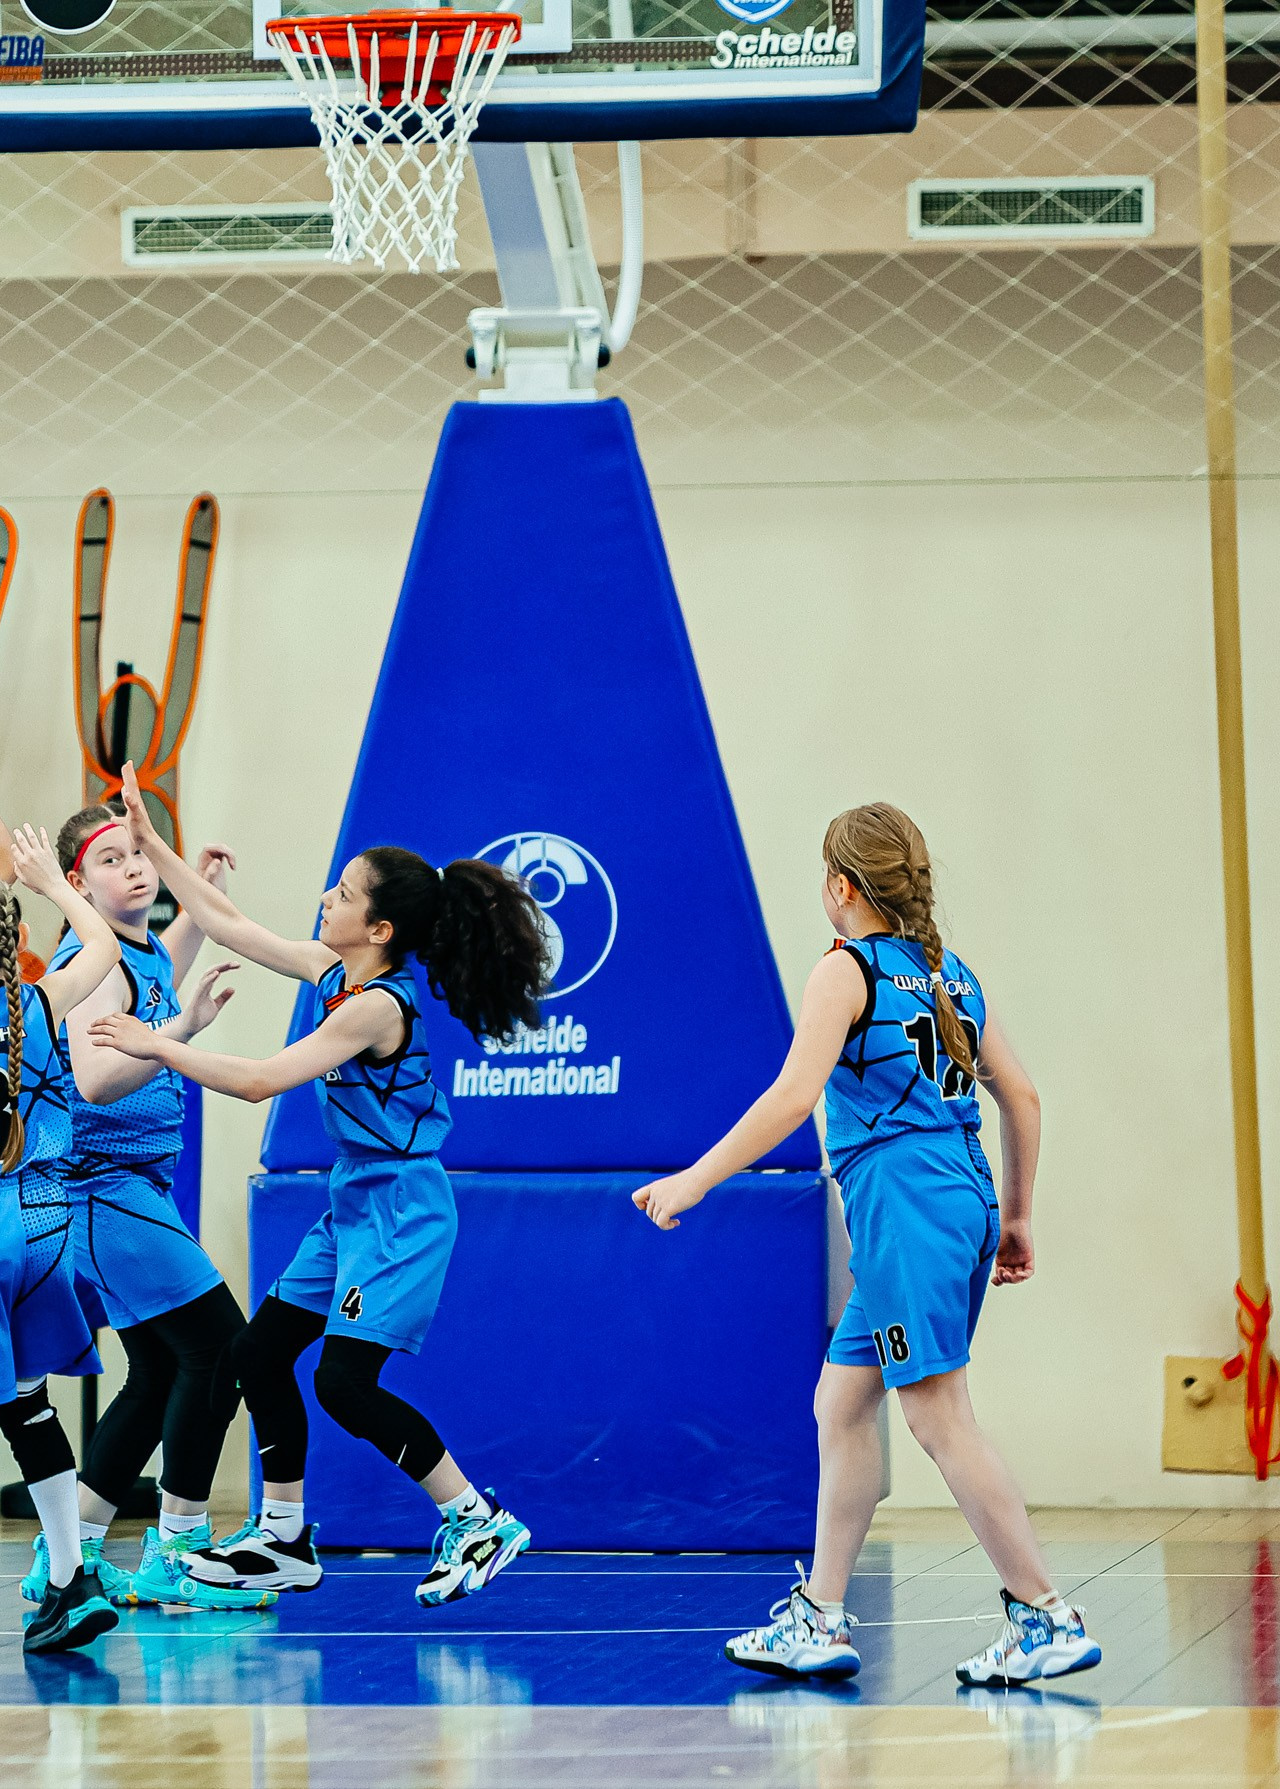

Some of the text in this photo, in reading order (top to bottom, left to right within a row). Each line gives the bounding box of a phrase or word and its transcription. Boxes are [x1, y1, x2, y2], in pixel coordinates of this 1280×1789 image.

[710, 25, 856, 68] Schelde
[733, 52, 852, 68] international
[892, 974, 976, 997] ШАТАОВА
[452, 1055, 621, 1097] International
[902, 1011, 980, 1102] 18
[338, 1285, 363, 1322] 4
[872, 1322, 911, 1369] 18
[472, 1538, 497, 1563] PEAK
